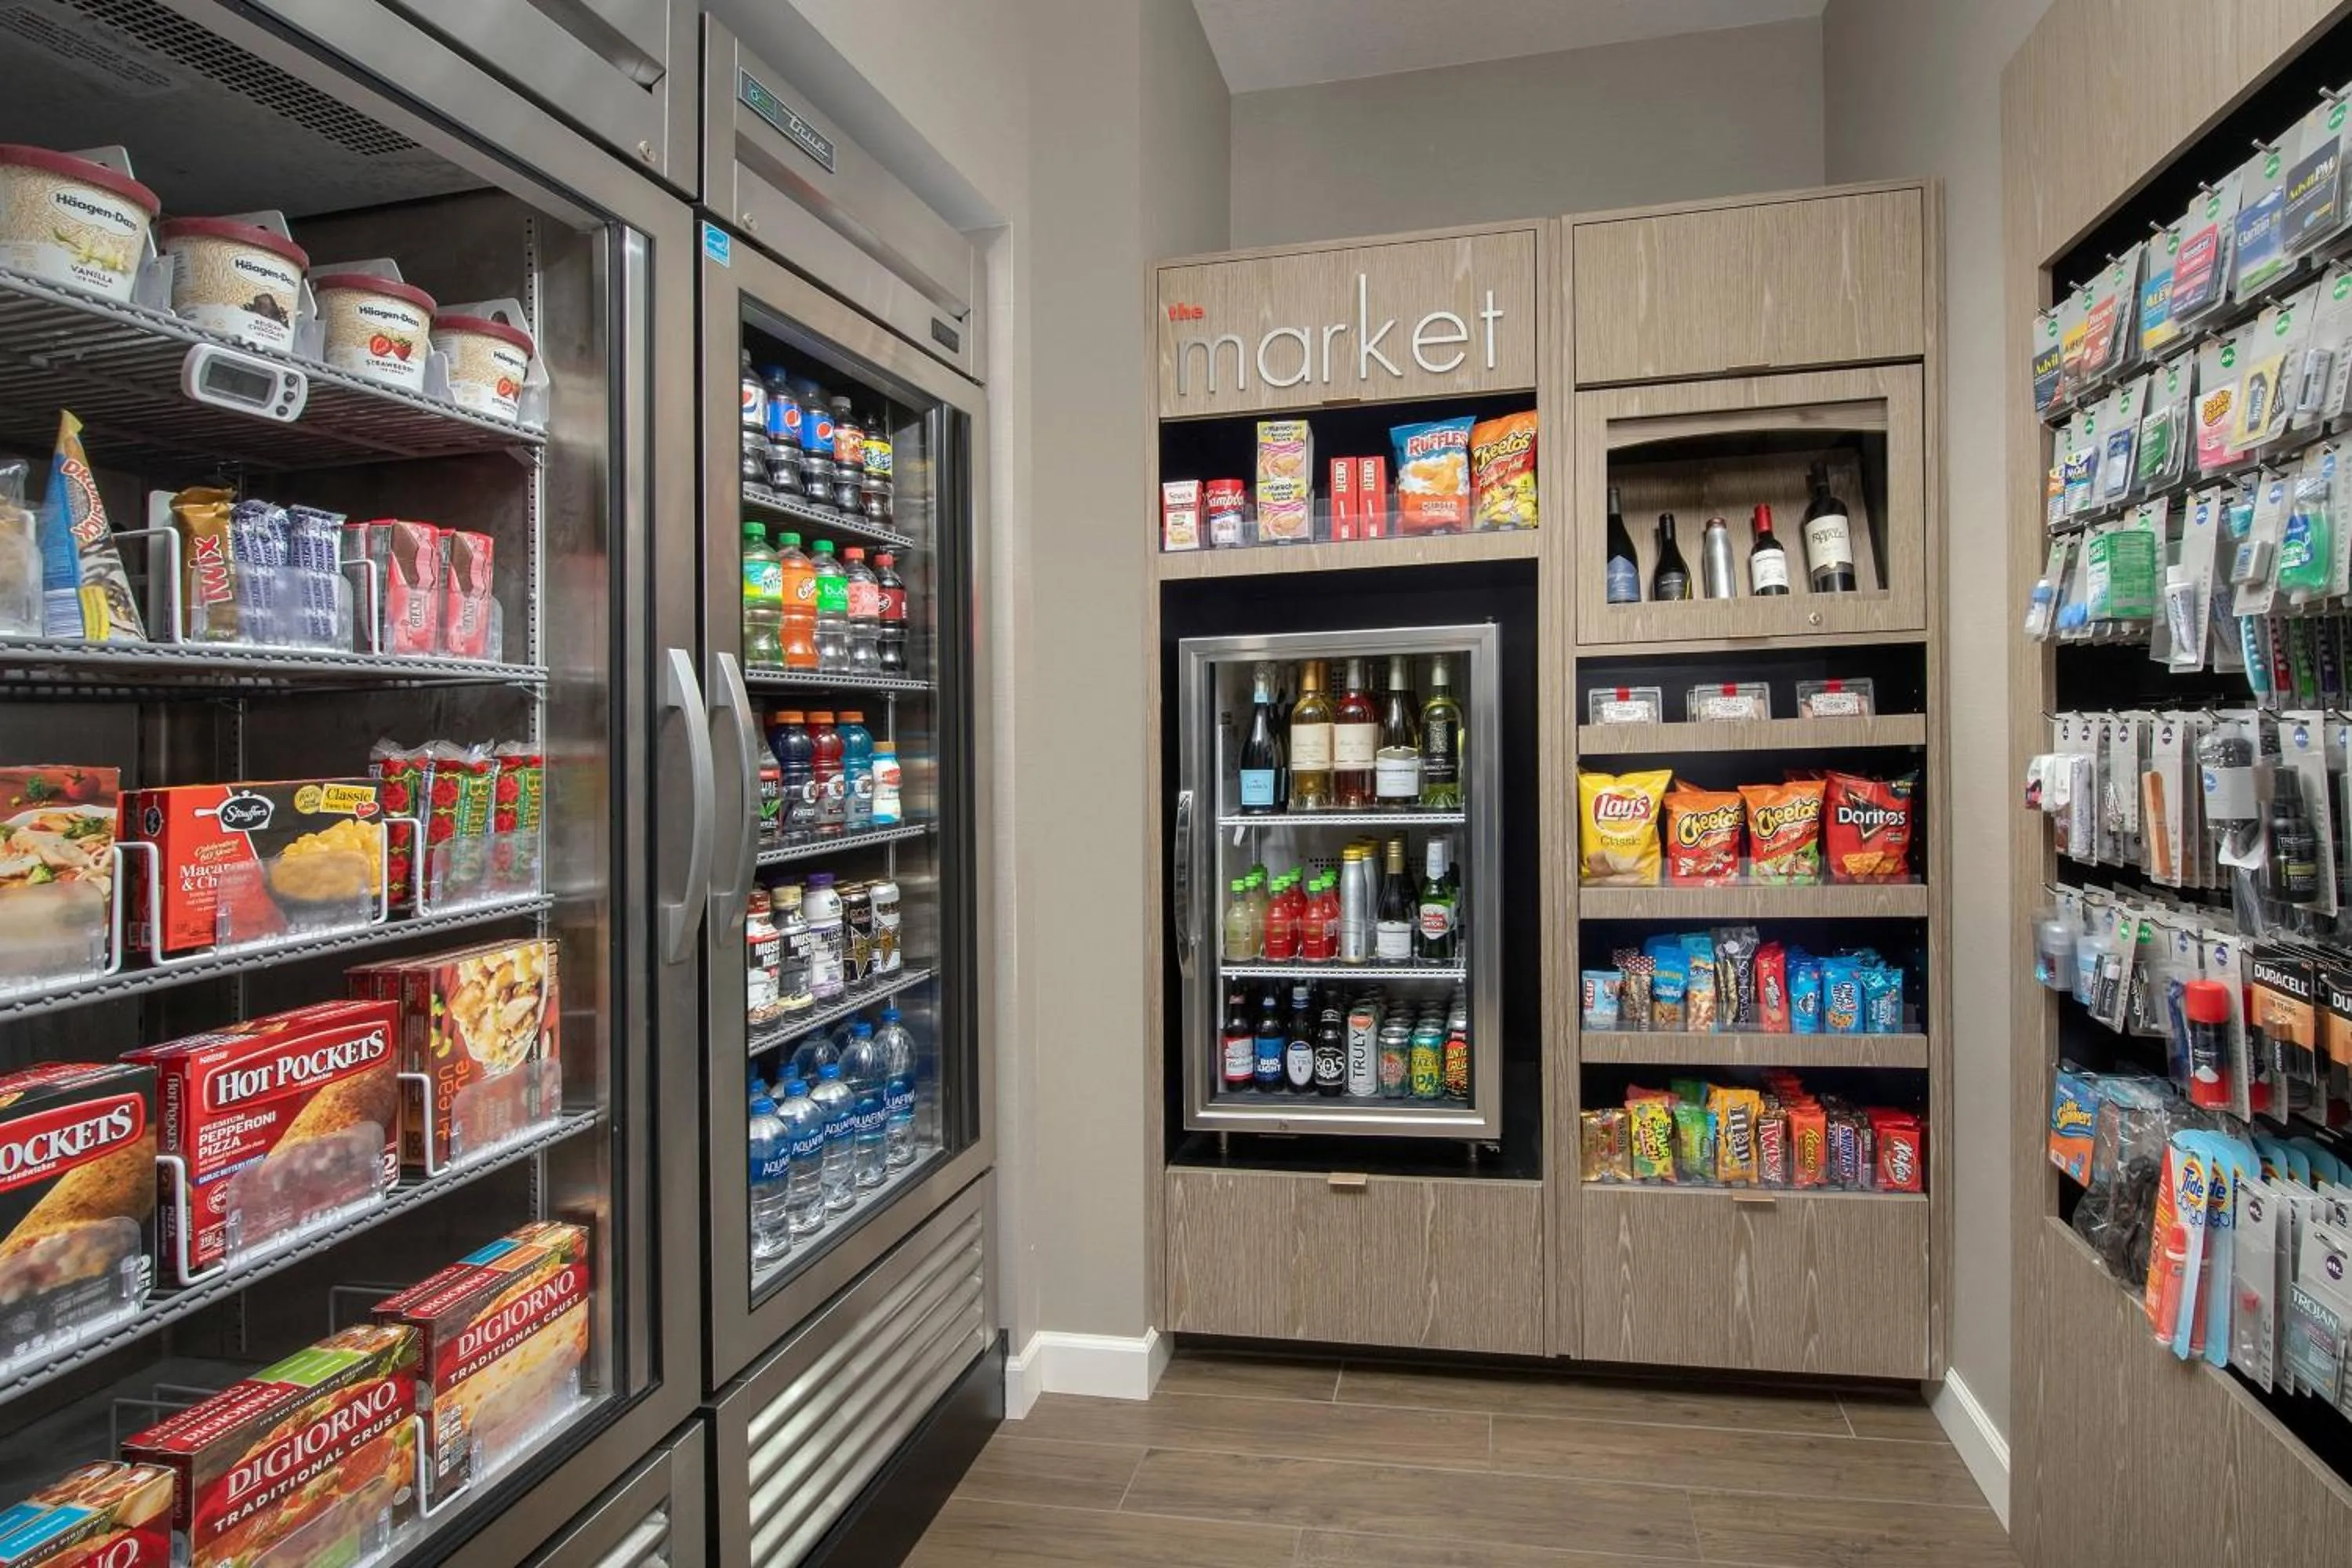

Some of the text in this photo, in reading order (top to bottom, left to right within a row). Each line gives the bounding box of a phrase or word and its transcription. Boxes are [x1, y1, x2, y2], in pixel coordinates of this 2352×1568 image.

[71, 264, 114, 285] VANILLA
[1168, 303, 1204, 321] the
[1177, 274, 1504, 394] market
[2034, 354, 2060, 376] Advil
[1406, 431, 1468, 457] RUFFLES
[1472, 432, 1534, 474] Cheetos
[325, 788, 372, 802] Classic
[1677, 806, 1744, 848] Cheetos
[1755, 800, 1819, 839] Cheetos
[1838, 806, 1907, 826] Doritos
[1599, 836, 1642, 847] Classic
[181, 877, 194, 891] &
[2253, 964, 2310, 996] DURACELL
[216, 1029, 387, 1105] HOT POCKETS
[1257, 1065, 1282, 1074] LIGHT
[1352, 1030, 1367, 1080] TRULY
[0, 1104, 133, 1175] OCKETS
[198, 1110, 277, 1146] PEPPERONI
[1642, 1117, 1661, 1161] PATCH
[1654, 1119, 1671, 1158] SOUR
[198, 1136, 241, 1160] PIZZA
[2183, 1166, 2205, 1198] Tide
[2209, 1177, 2227, 1200] de
[457, 1269, 576, 1359] DIGIORNO
[2292, 1288, 2338, 1331] TROJAN
[448, 1292, 580, 1385] TRADITIONAL CRUST
[180, 1388, 281, 1443] DIGIORNO
[226, 1380, 398, 1503] DIGIORNO
[213, 1445, 344, 1534] TRADITIONAL
[349, 1407, 403, 1449] CRUST
